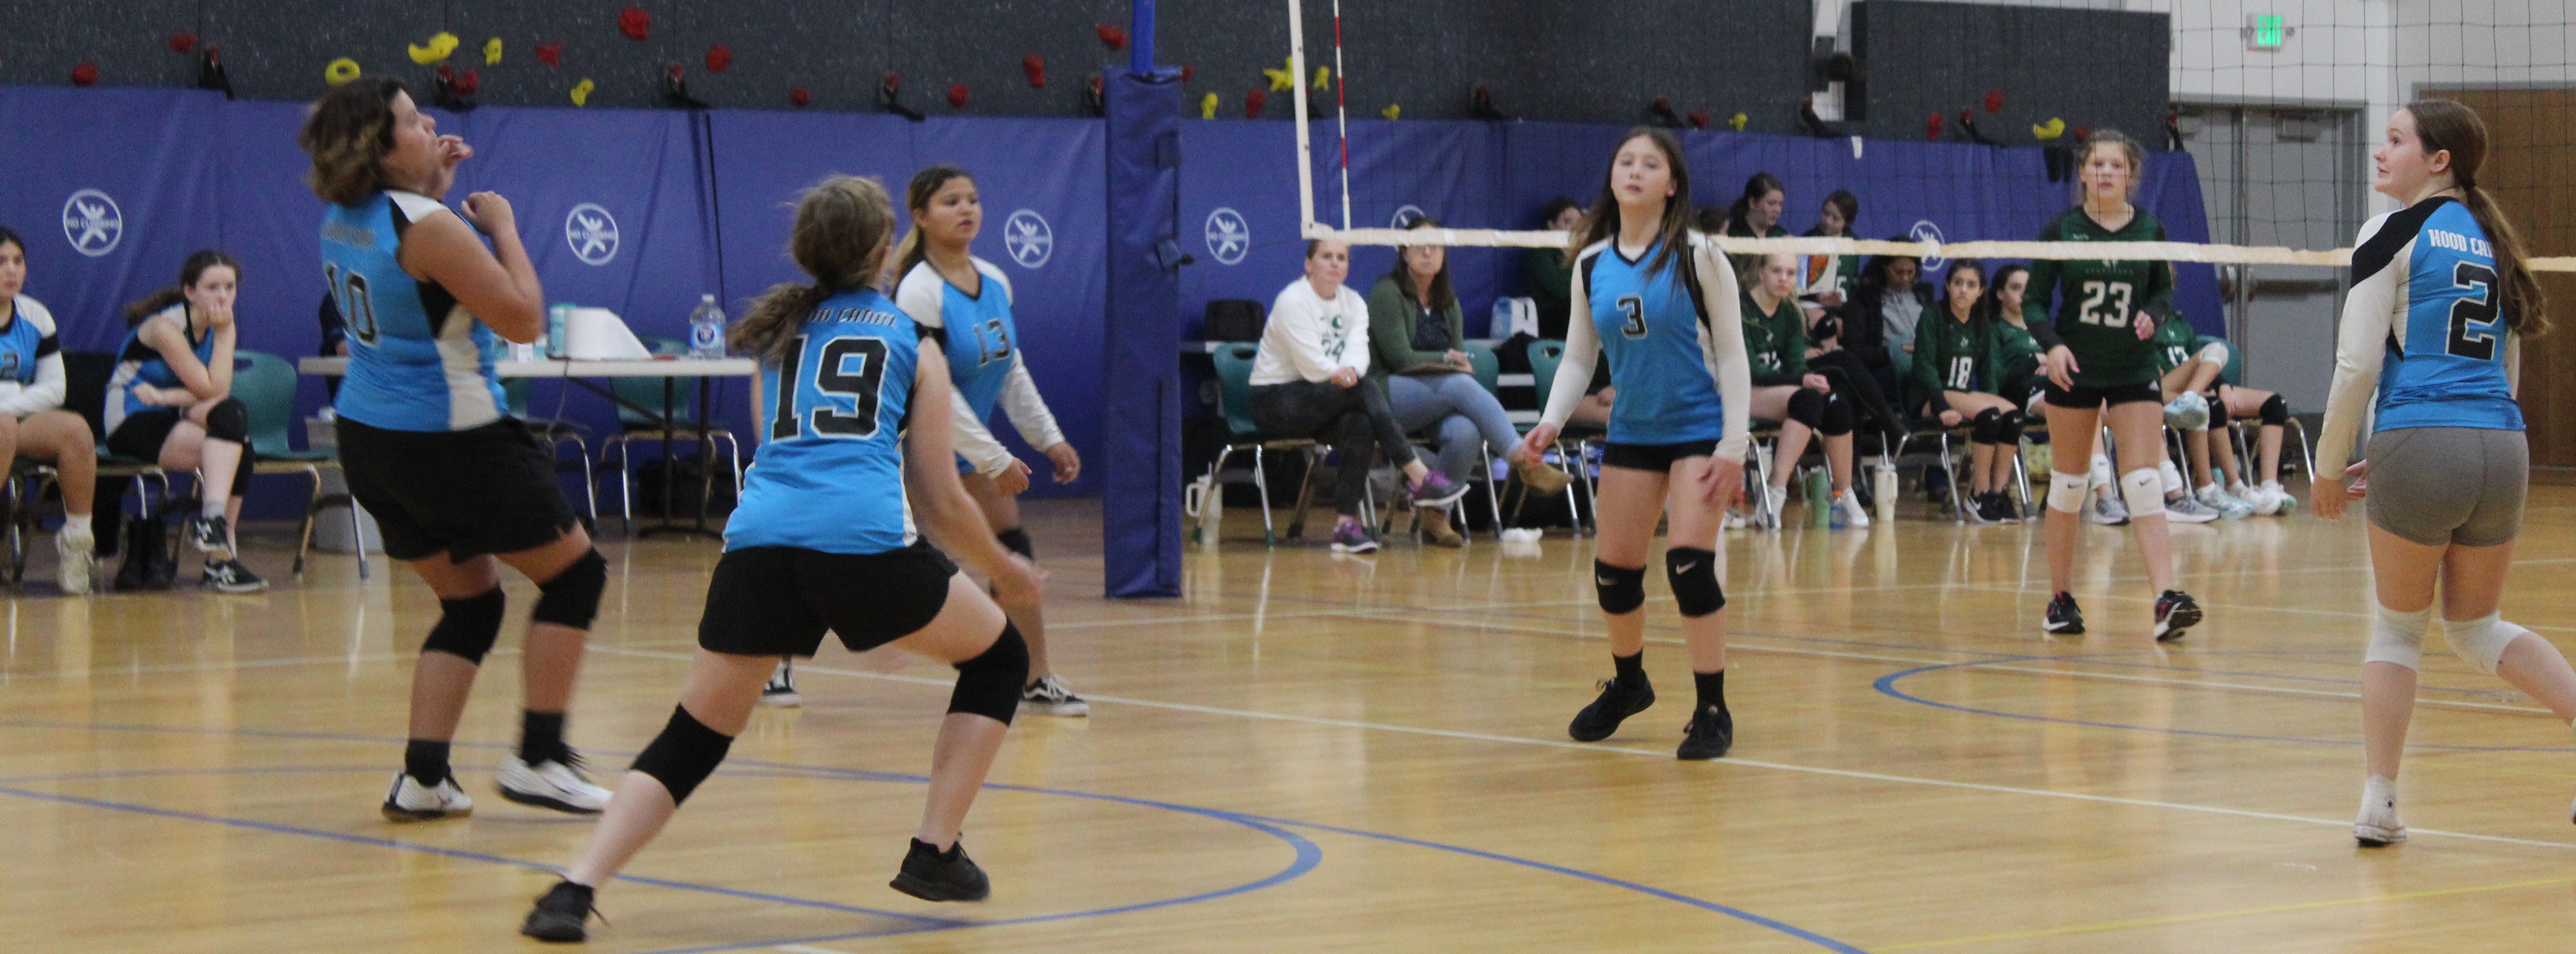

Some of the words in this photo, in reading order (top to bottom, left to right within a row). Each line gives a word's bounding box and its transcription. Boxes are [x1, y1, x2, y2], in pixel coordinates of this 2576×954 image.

[2258, 15, 2281, 45] EXIT
[2428, 229, 2468, 252] HOOD
[323, 261, 382, 347] 10
[1616, 293, 1648, 341] 3
[2079, 280, 2133, 328] 23
[2445, 260, 2500, 360] 2
[972, 318, 1010, 367] 13
[770, 334, 891, 444] 19
[1947, 355, 1973, 389] 18
